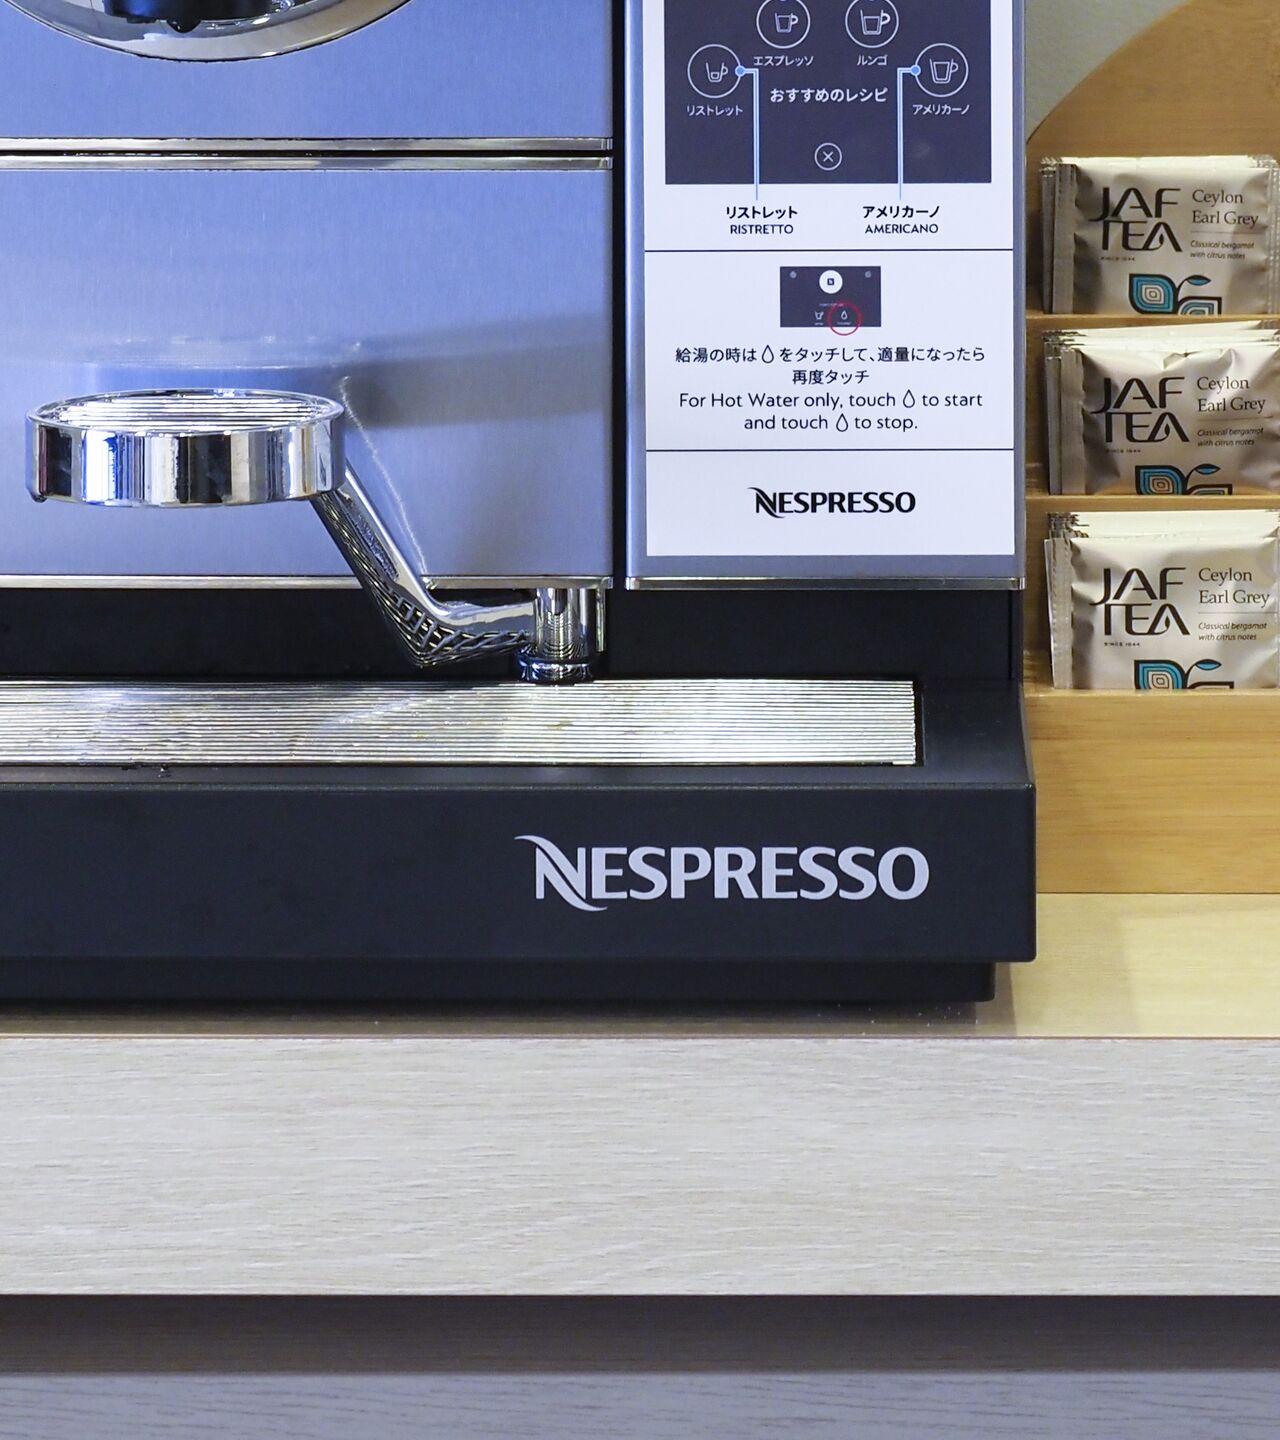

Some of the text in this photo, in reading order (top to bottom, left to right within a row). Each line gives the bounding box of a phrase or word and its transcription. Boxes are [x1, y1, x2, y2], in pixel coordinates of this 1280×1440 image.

[753, 55, 814, 67] エスプレッソ
[857, 54, 888, 66] ルンゴ
[770, 88, 888, 103] おすすめのレシピ
[687, 104, 743, 116] リストレット
[912, 104, 970, 116] アメリカーノ
[1192, 189, 1243, 204] Ceylon
[726, 206, 798, 219] リストレット
[862, 205, 940, 218] アメリカーノ
[1192, 211, 1258, 228] Earl Grey
[730, 224, 794, 234] RISTRETTO
[865, 224, 938, 234] AMERICANO
[1102, 220, 1182, 252] TEA
[675, 347, 985, 363] 給湯の時は をタッチして、適量になったら
[792, 370, 870, 384] 再度タッチ
[1197, 377, 1249, 392] Ceylon
[679, 392, 982, 410] For Hot Water only, touch to start
[1197, 398, 1266, 413] Earl Grey
[744, 415, 918, 432] and touch to stop.
[1105, 412, 1189, 443] TEA
[747, 487, 916, 518] NESPRESSO
[1198, 568, 1252, 586] Ceylon
[1199, 590, 1270, 608] Earl Grey
[1104, 603, 1190, 635] TEA
[514, 835, 930, 911] NESPRESSO
